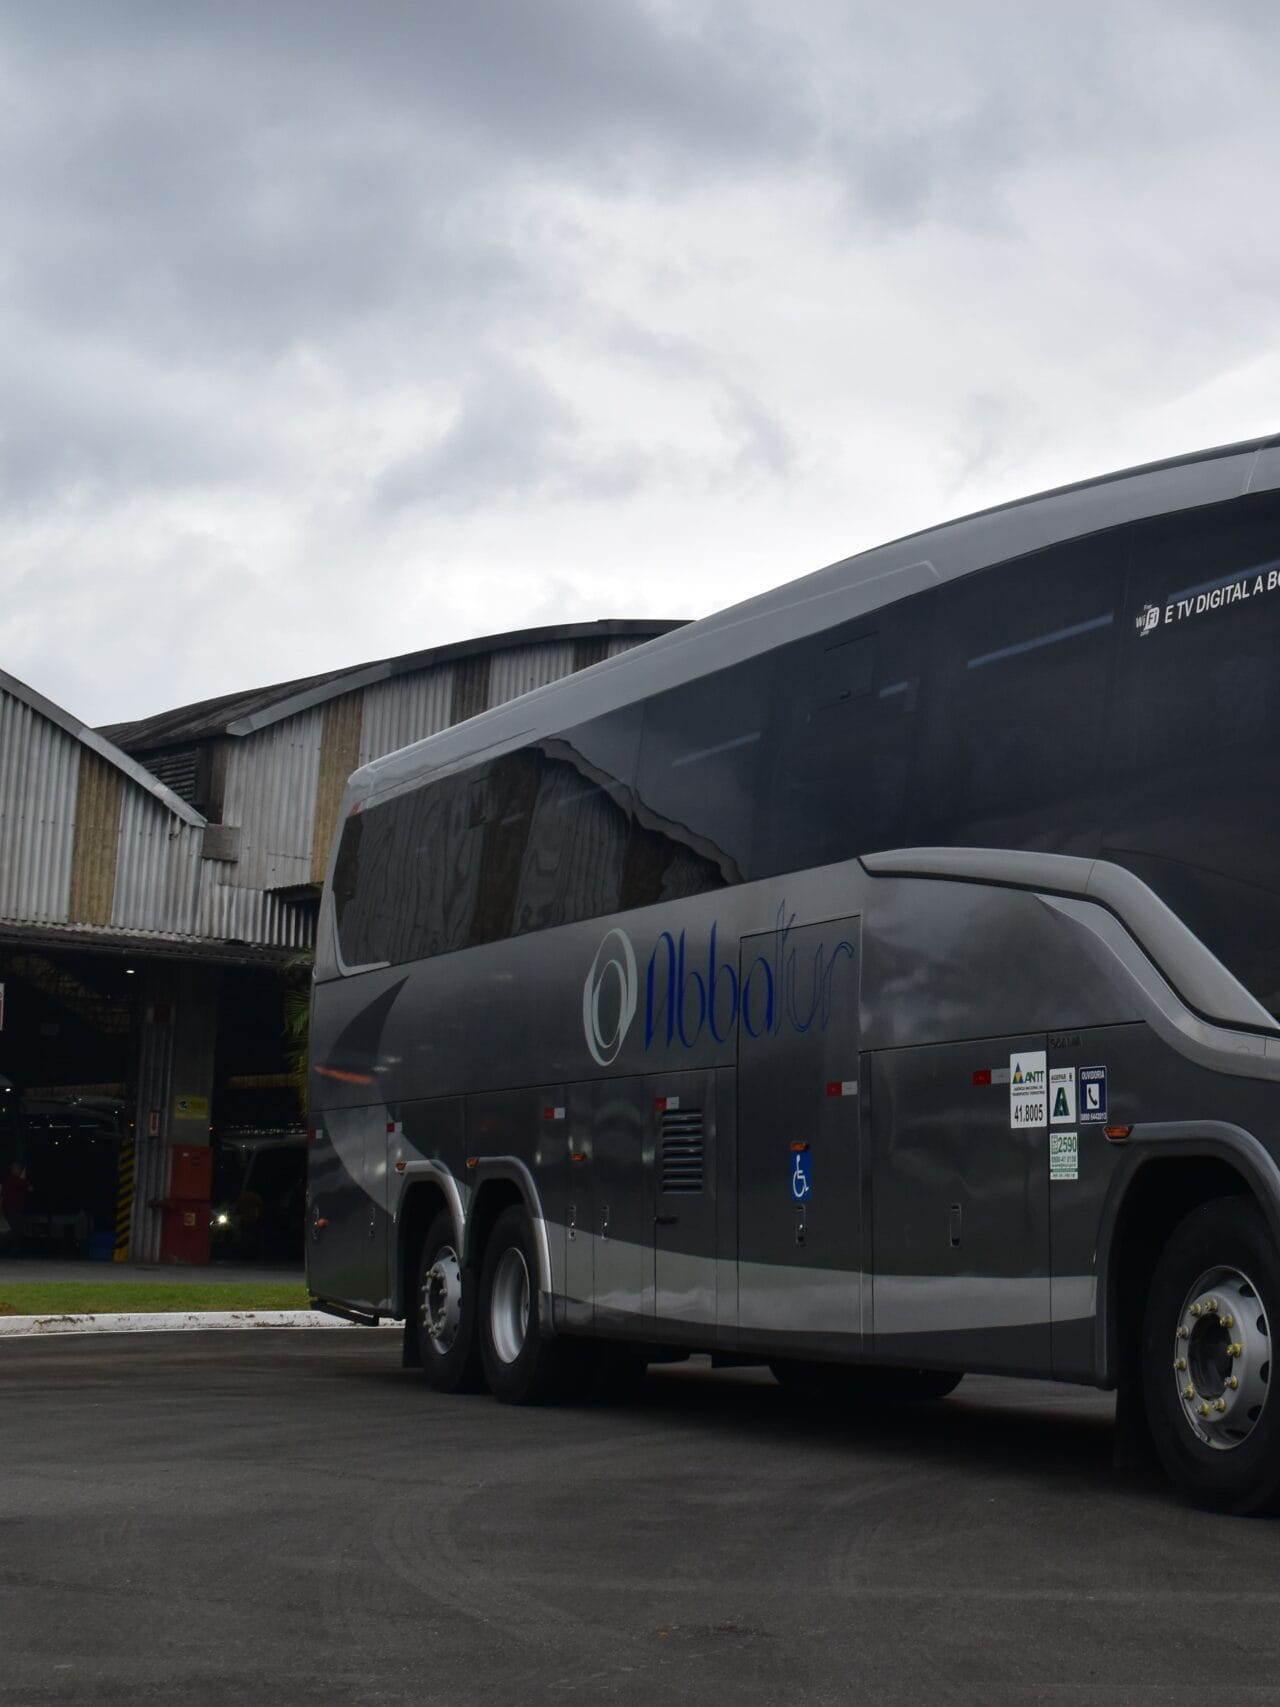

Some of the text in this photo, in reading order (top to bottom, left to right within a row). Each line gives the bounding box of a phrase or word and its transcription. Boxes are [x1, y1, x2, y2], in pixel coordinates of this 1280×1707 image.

[1164, 604, 1175, 624] E
[1176, 599, 1193, 620] TV
[1196, 579, 1250, 613] DIGITAL
[1253, 577, 1264, 596] A
[1024, 1070, 1045, 1085] ANTT
[1014, 1103, 1044, 1123] 41.8005
[1058, 1136, 1077, 1153] 2590
